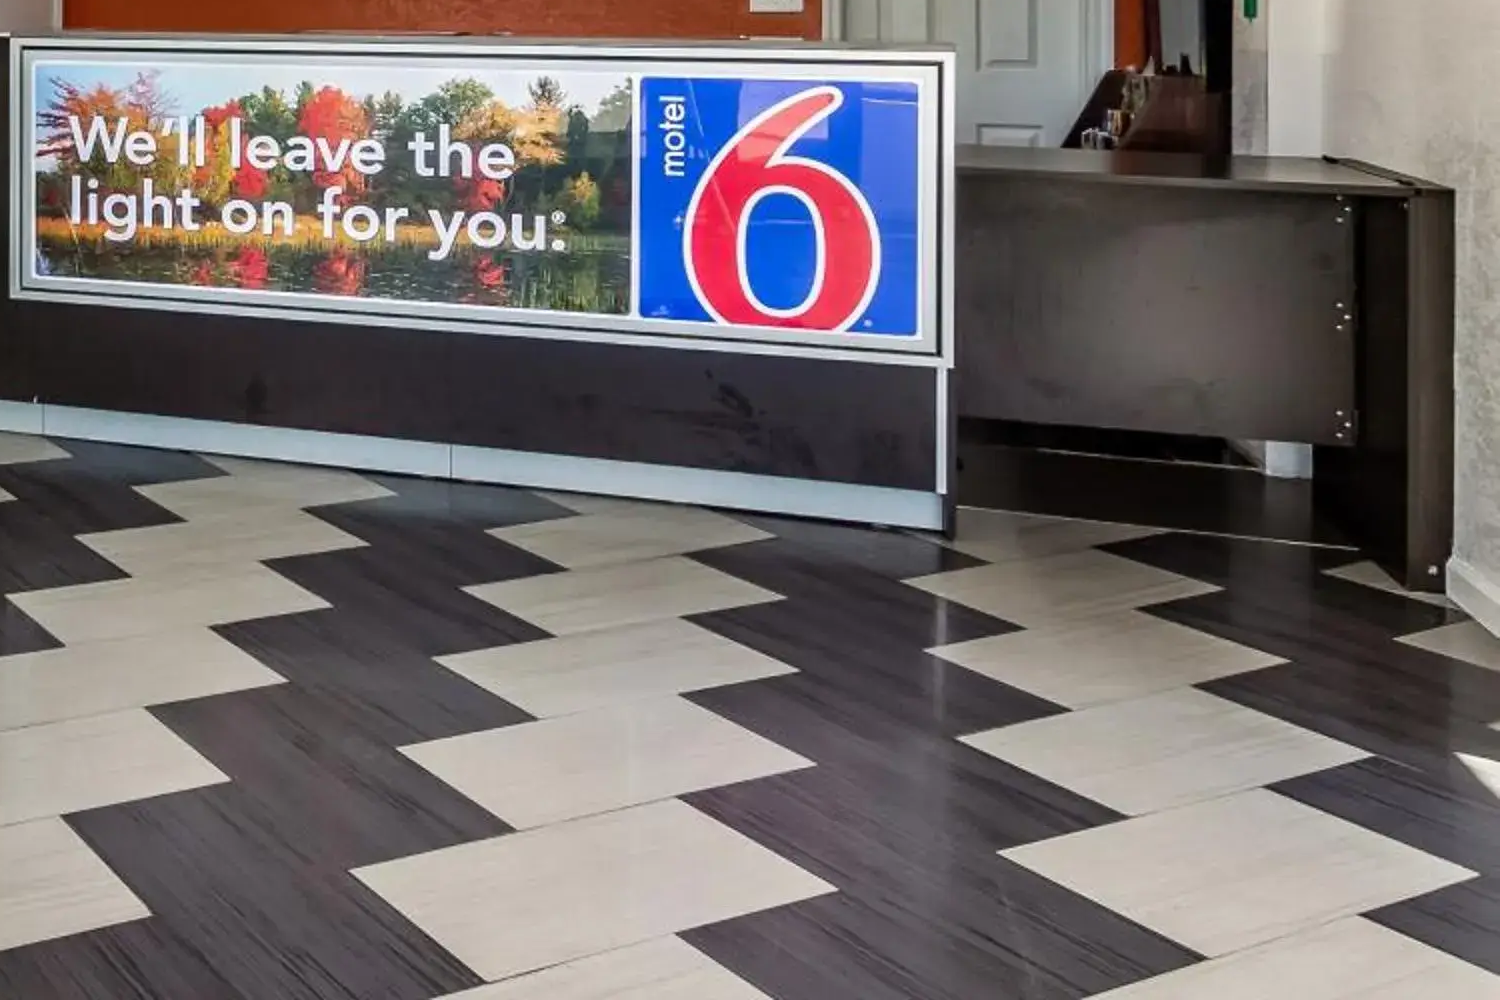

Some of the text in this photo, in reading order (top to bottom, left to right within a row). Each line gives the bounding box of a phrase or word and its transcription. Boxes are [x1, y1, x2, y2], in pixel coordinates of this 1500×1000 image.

[69, 114, 516, 181] We'll leave the
[658, 95, 685, 178] motel
[68, 175, 202, 243] light
[220, 198, 295, 238] on
[315, 187, 409, 243] for
[683, 85, 882, 334] 6
